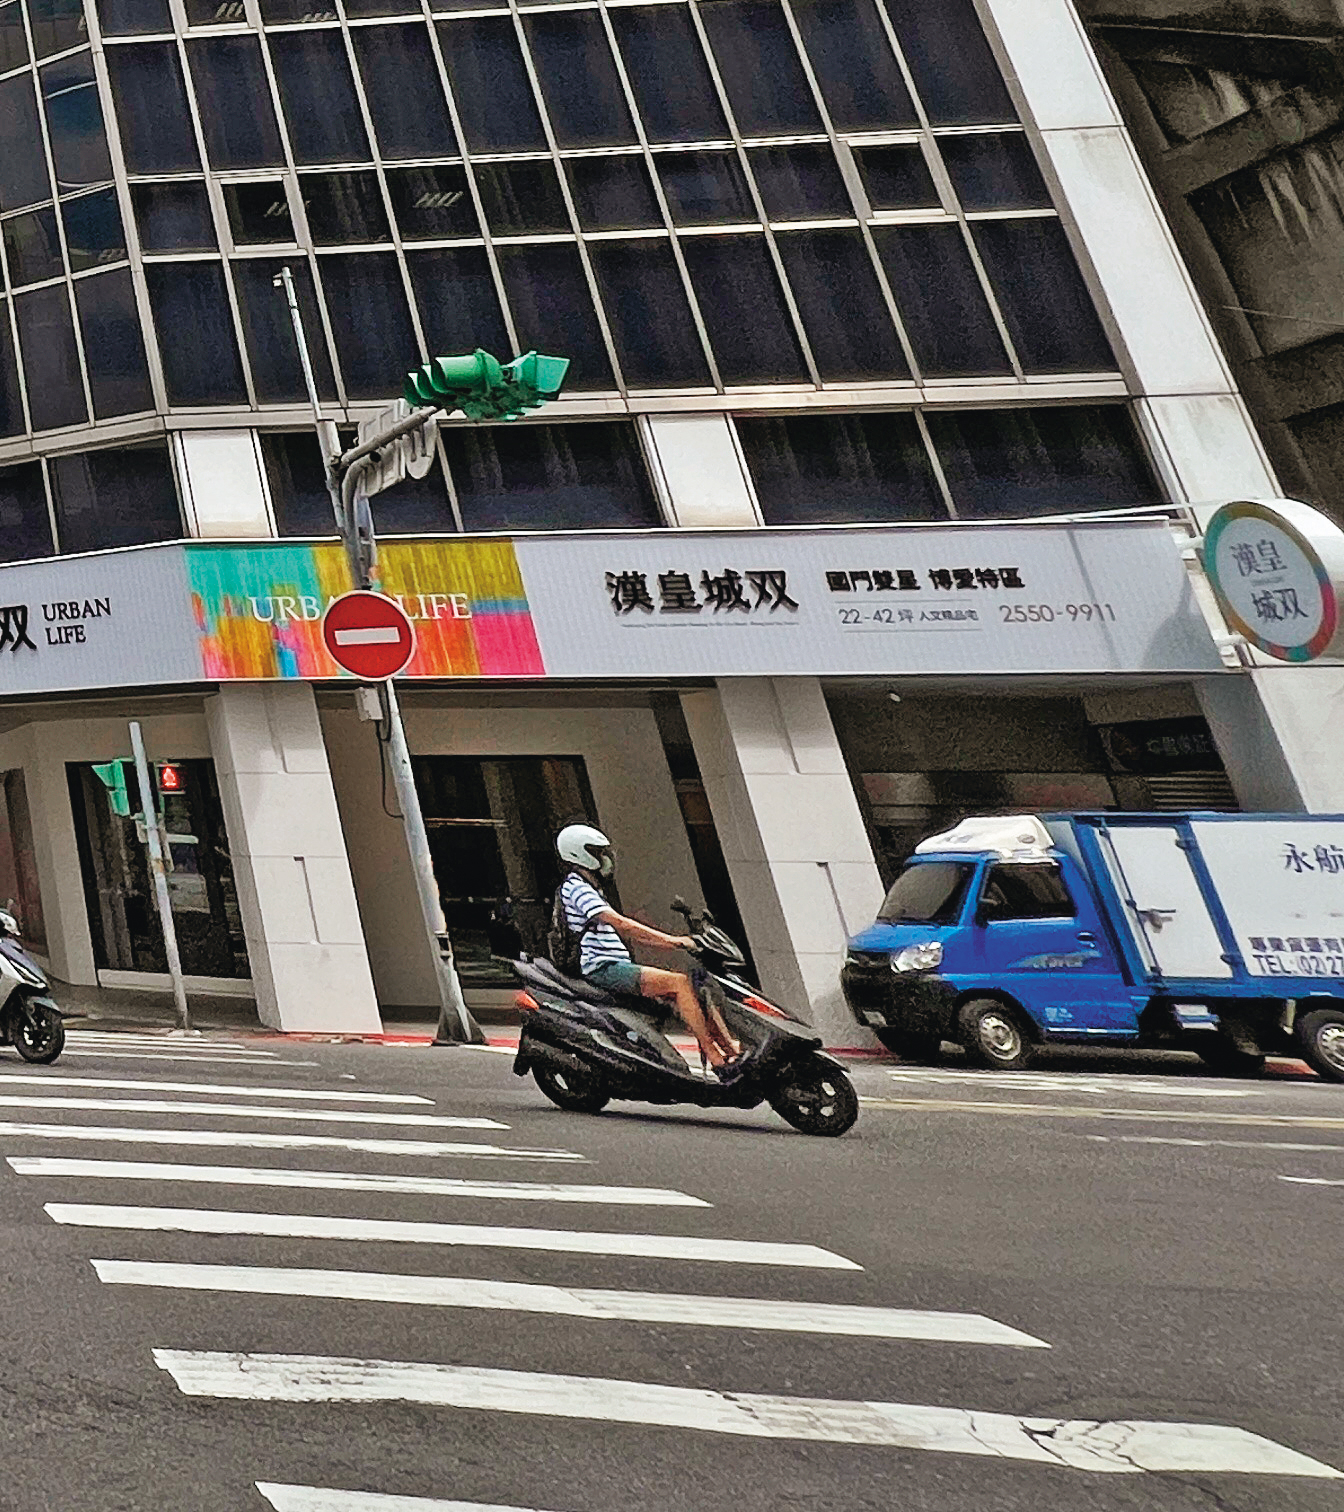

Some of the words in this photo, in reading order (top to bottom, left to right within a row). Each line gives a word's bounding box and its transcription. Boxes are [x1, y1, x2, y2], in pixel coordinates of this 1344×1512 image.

[42, 597, 111, 622] URBAN
[248, 595, 335, 622] URB
[999, 603, 1116, 623] 2550-9911
[1250, 588, 1310, 623] 城双
[45, 624, 87, 646] LIFE
[1280, 842, 1344, 874] 永航
